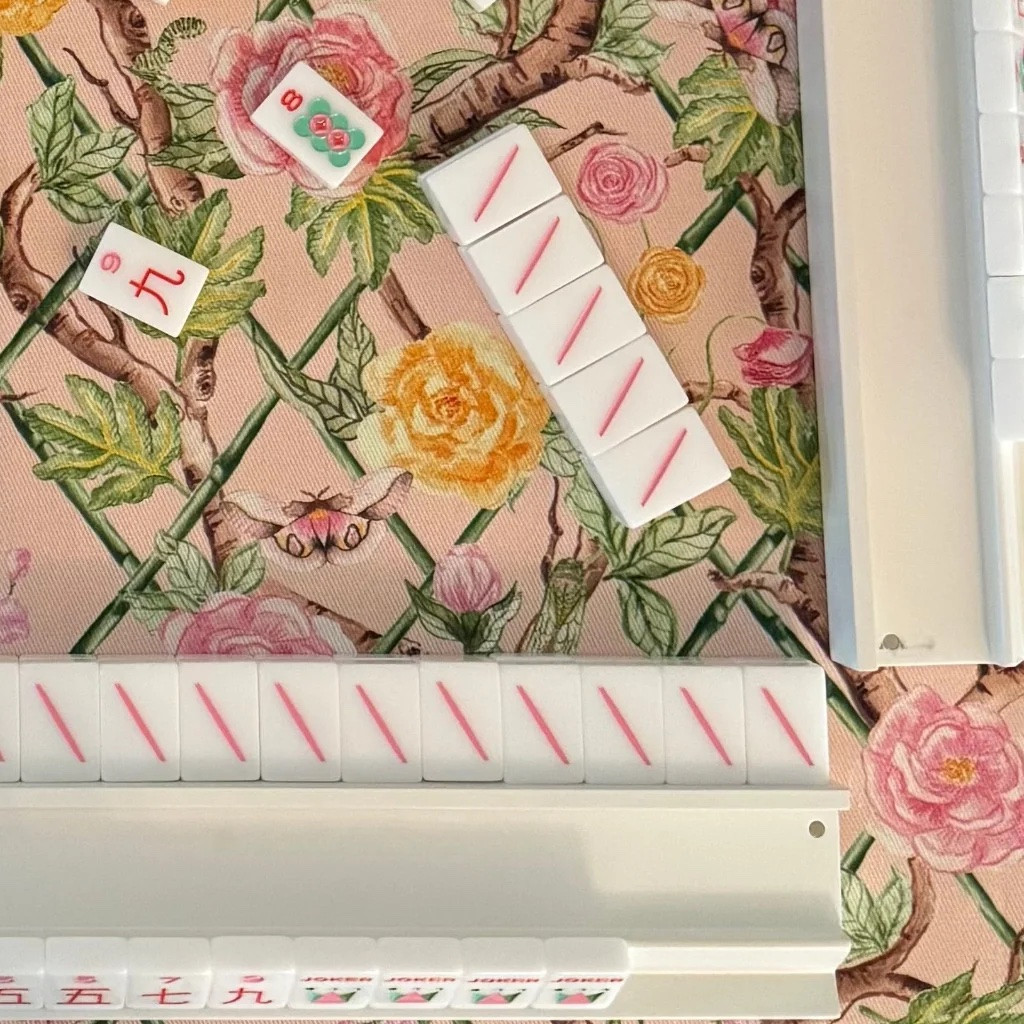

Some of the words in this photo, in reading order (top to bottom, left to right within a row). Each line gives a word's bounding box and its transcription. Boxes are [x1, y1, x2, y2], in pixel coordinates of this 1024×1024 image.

[280, 88, 303, 112] 8
[100, 251, 122, 273] 9
[128, 266, 187, 317] 九
[57, 988, 112, 1005] 五
[141, 988, 192, 1005] 七
[223, 988, 273, 1005] 九
